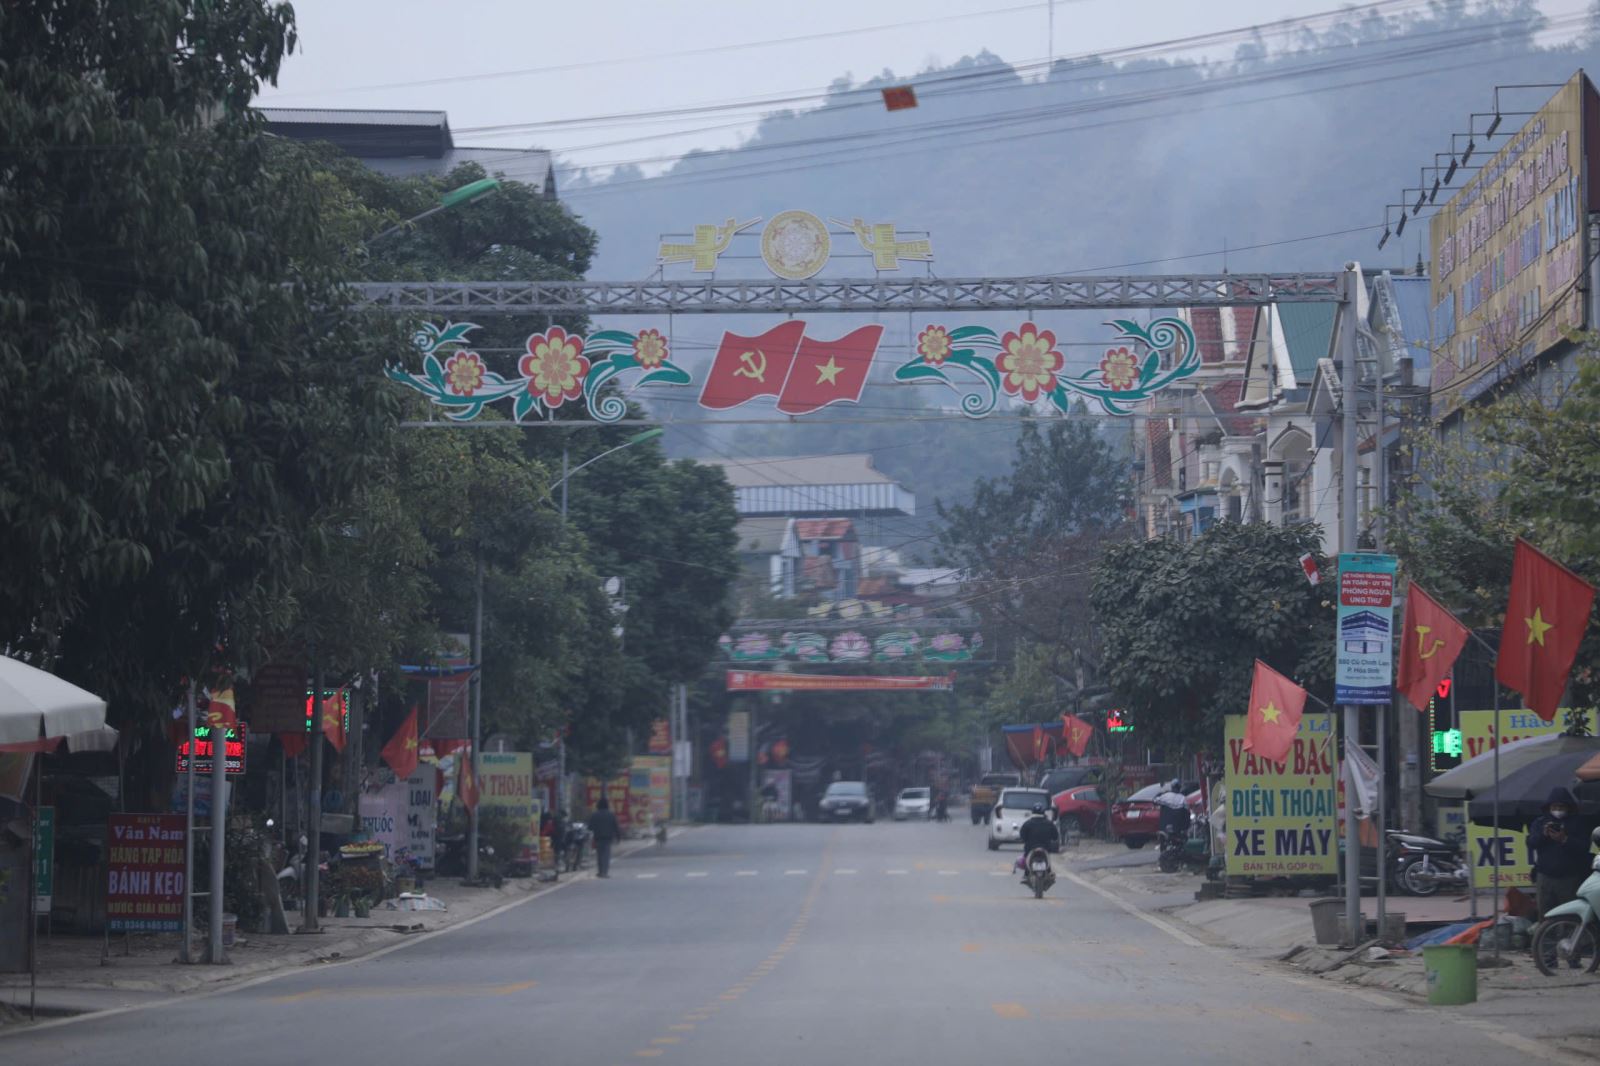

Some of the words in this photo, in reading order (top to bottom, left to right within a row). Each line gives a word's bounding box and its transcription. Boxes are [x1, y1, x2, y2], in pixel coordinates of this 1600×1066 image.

[1232, 784, 1275, 823] ĐIỆN
[1280, 789, 1332, 823] THOẠI
[114, 825, 144, 840] Vân
[148, 826, 184, 841] Nam
[1234, 829, 1265, 856] XE
[1275, 823, 1332, 856] MÁY
[1476, 837, 1516, 866] XE
[109, 865, 150, 895] BÁNH
[154, 871, 184, 901] KẸO
